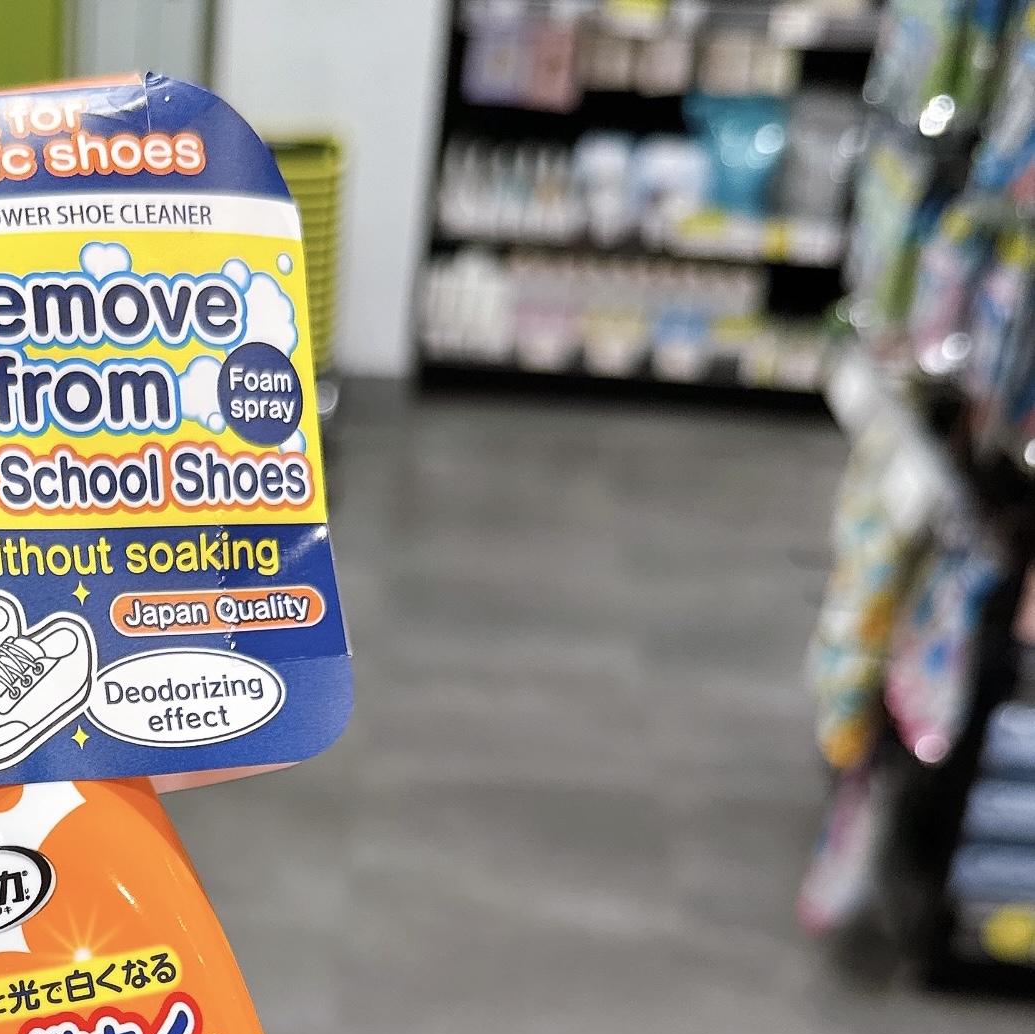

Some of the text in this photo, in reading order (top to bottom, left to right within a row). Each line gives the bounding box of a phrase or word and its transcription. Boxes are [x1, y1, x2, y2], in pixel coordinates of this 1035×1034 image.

[8, 101, 82, 134] for
[48, 134, 202, 172] shoes
[57, 203, 115, 225] SHOE
[119, 203, 213, 226] CLEANER
[229, 366, 292, 392] Foam
[229, 397, 295, 423] spray
[0, 453, 160, 503] School
[174, 452, 306, 502] Shoes
[125, 532, 280, 575] soaking
[123, 594, 310, 630] Japan Quality
[104, 674, 265, 706] Deodorizing
[147, 704, 231, 733] effect
